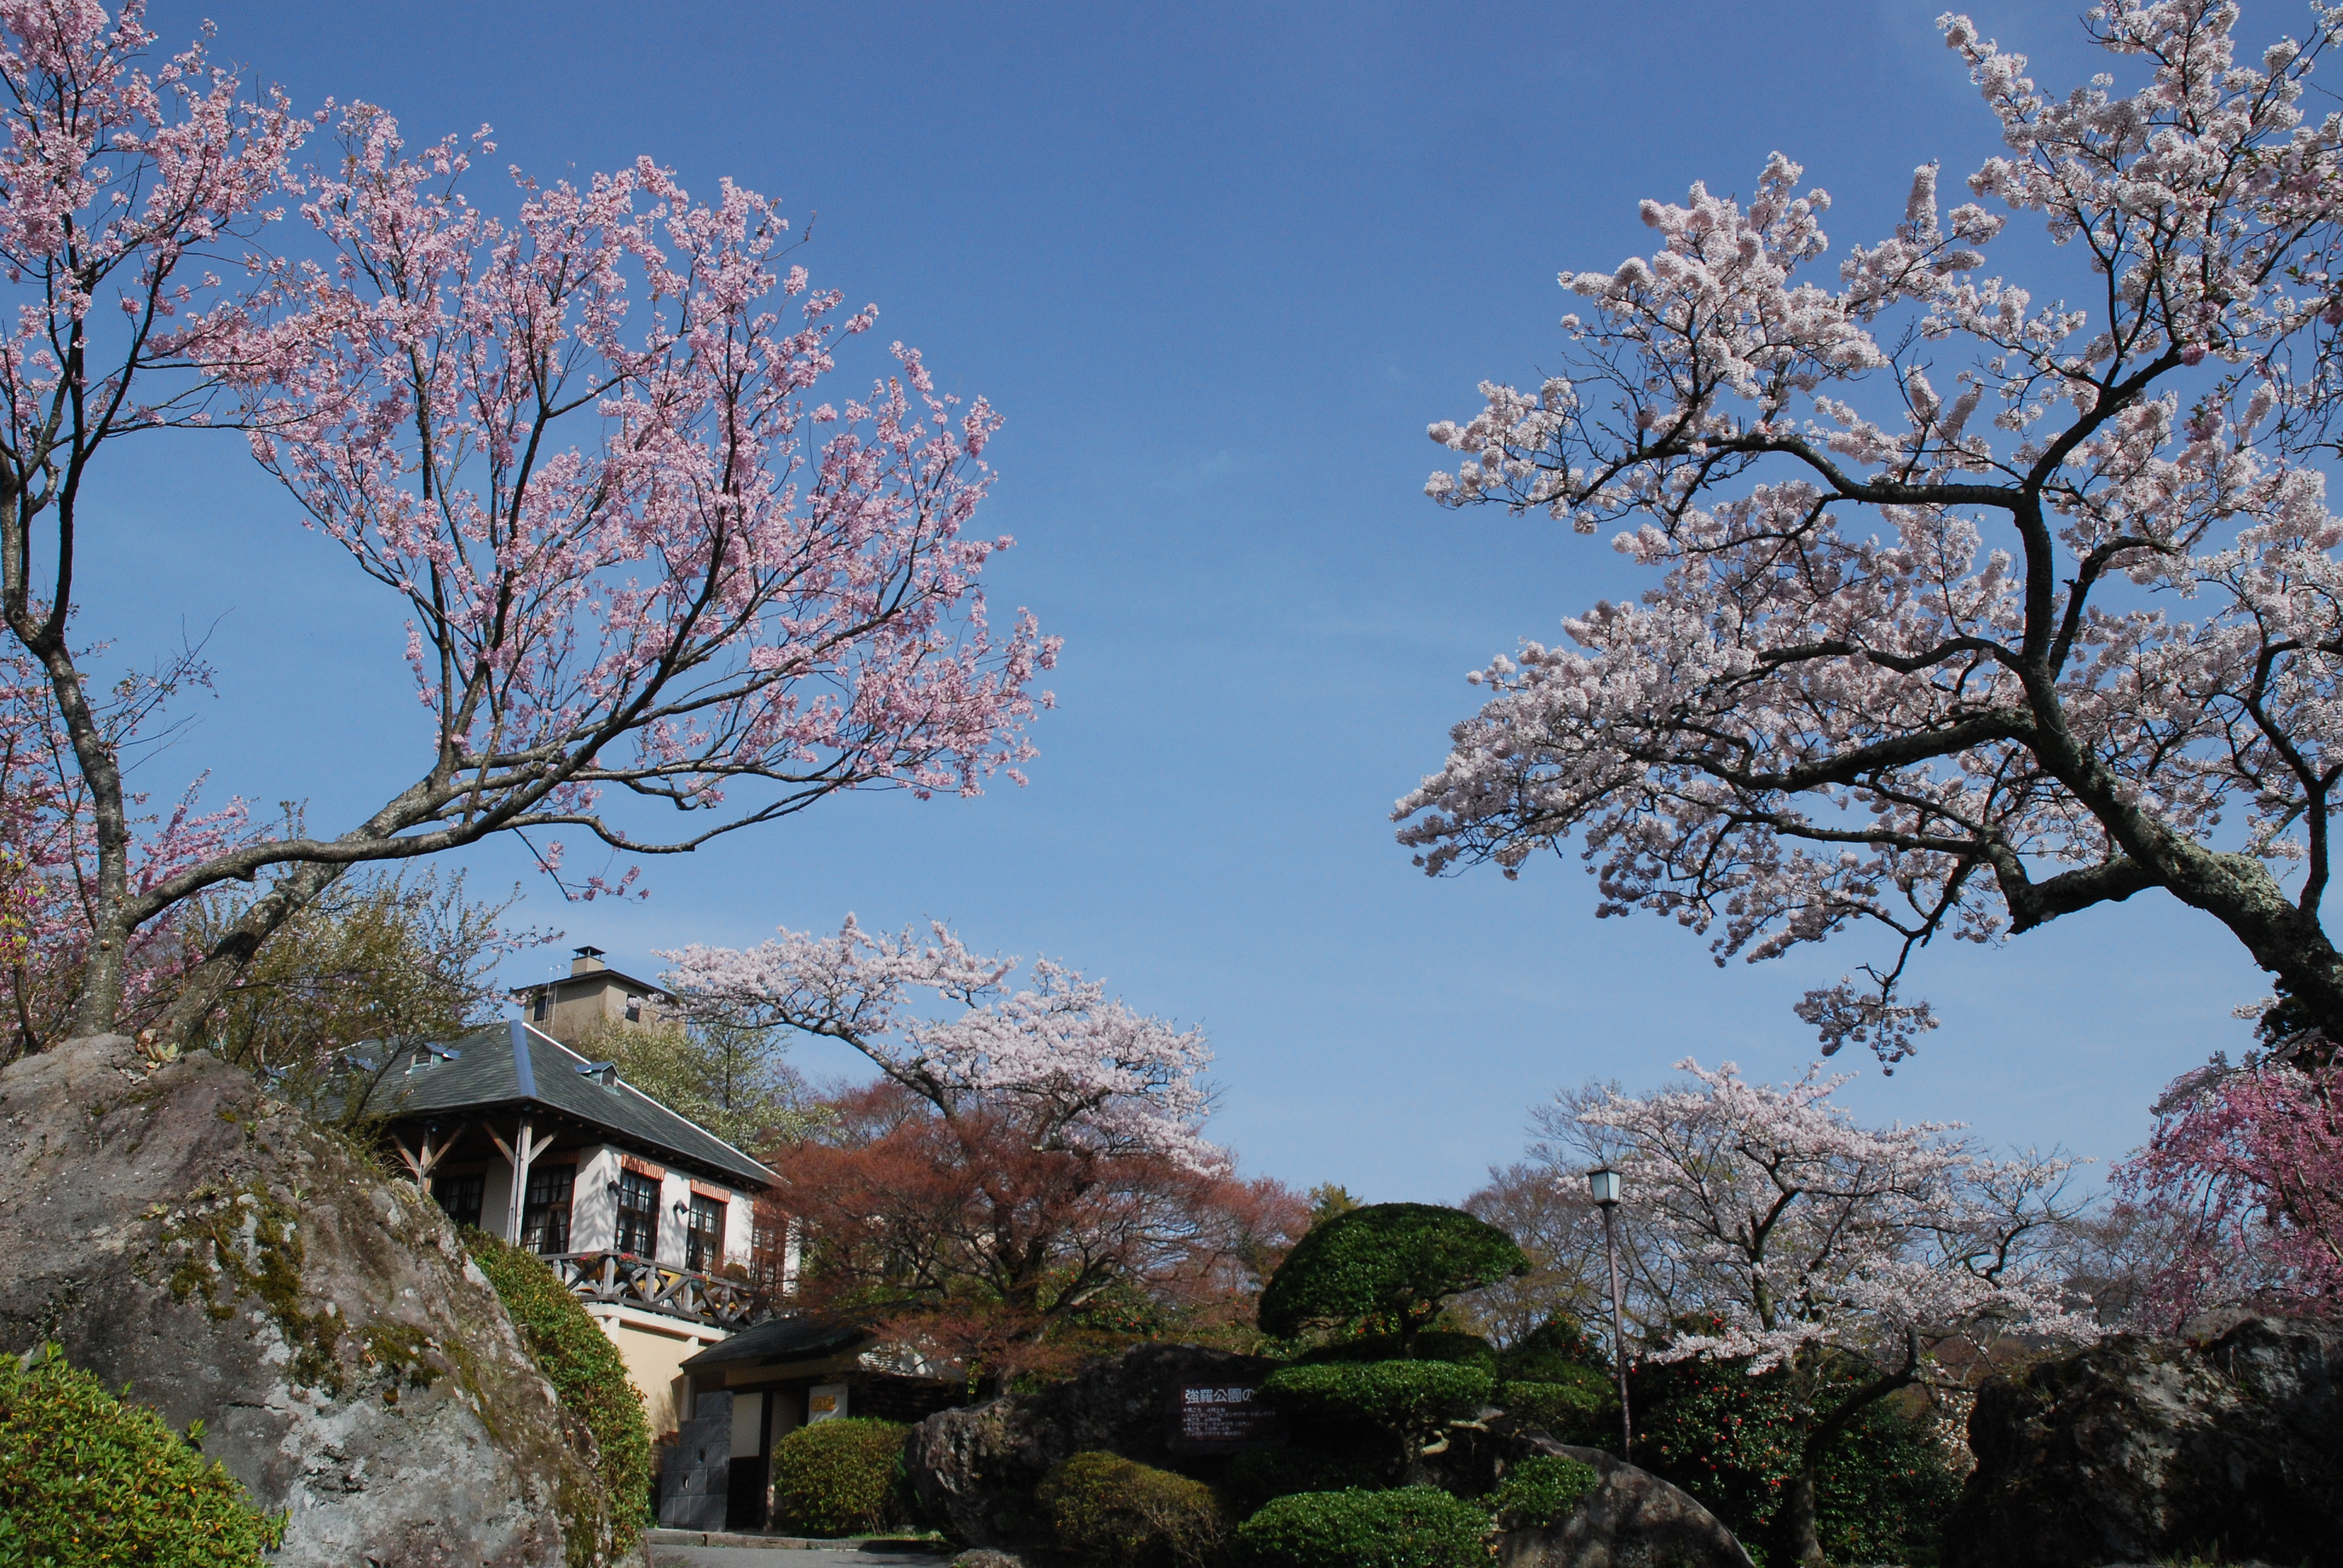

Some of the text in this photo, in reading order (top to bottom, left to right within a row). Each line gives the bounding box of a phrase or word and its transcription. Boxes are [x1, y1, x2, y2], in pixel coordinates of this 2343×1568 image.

[1185, 1388, 1254, 1404] 強羅公園の
